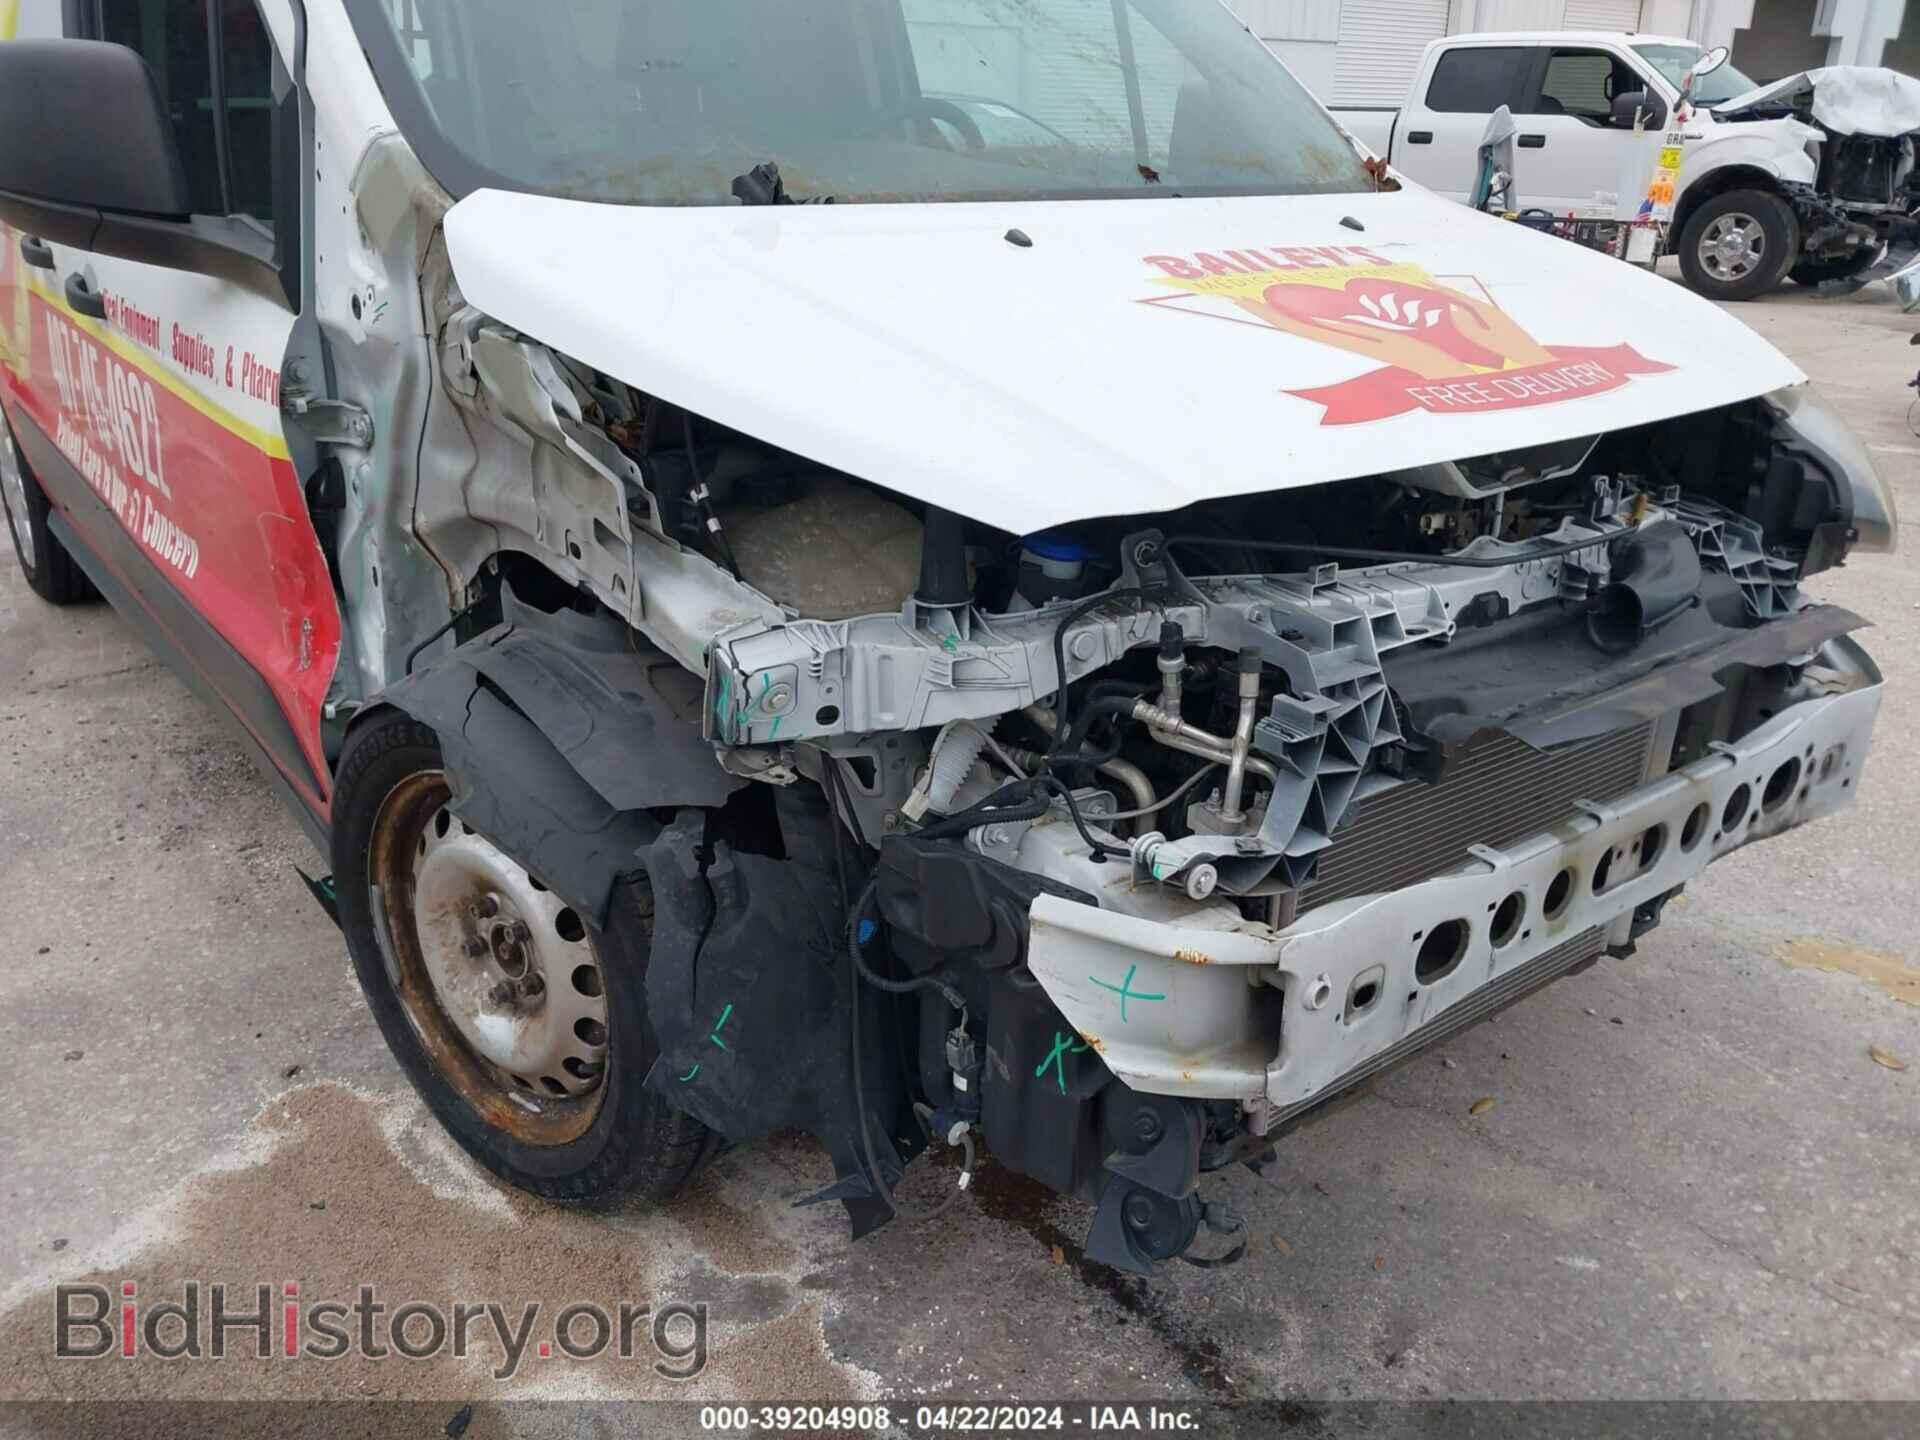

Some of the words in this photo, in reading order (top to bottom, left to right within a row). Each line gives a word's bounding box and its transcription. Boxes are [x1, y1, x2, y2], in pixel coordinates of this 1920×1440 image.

[1142, 245, 1393, 279] BAILEY'S
[225, 344, 234, 388] &
[1405, 381, 1504, 407] FREE
[1491, 360, 1616, 399] DELIVERY
[142, 495, 199, 579] Concern
